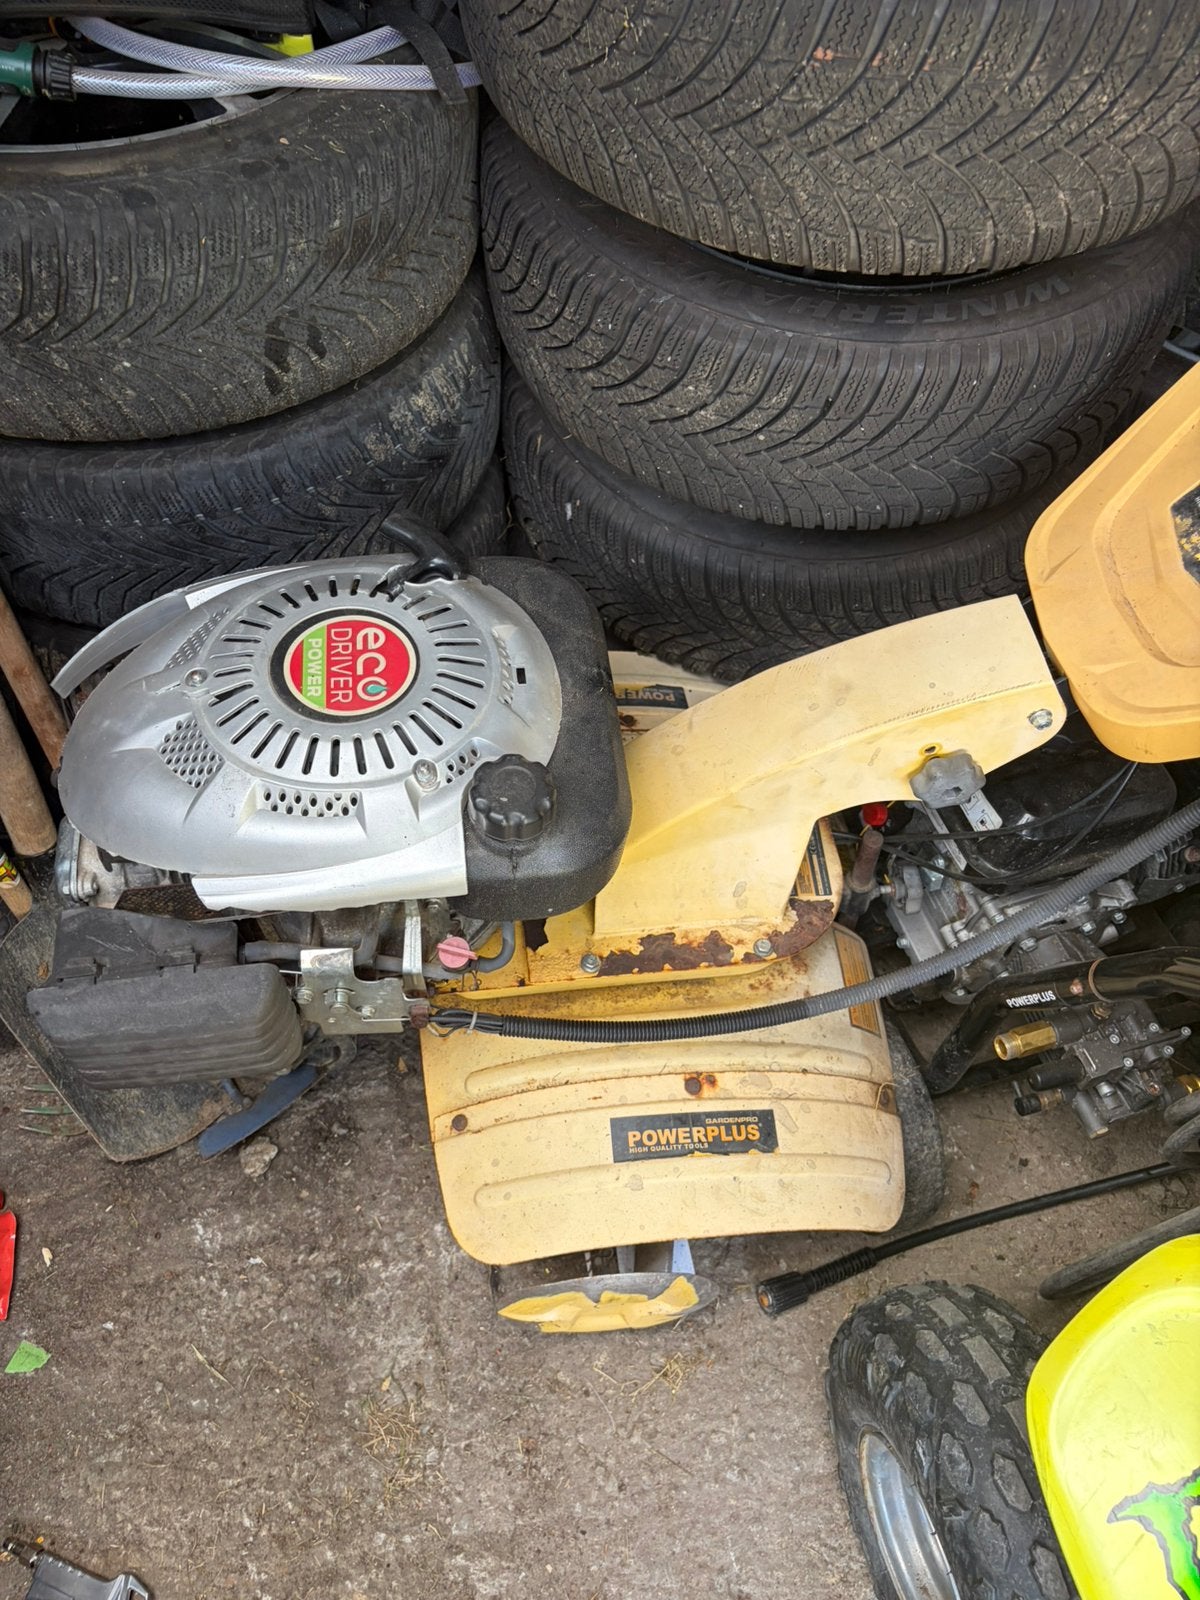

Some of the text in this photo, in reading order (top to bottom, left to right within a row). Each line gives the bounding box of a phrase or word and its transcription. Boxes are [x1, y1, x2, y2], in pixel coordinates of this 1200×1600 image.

[306, 638, 323, 697] POWER
[330, 627, 353, 703] DRIVER
[356, 627, 388, 702] eco
[616, 689, 675, 702] POWER
[1006, 990, 1056, 1008] POWERPLUS
[705, 1115, 758, 1125] GARDENPRO
[628, 1124, 760, 1147] POWERPLUS
[629, 1142, 708, 1154] HIGH QUALITY TOOLS
